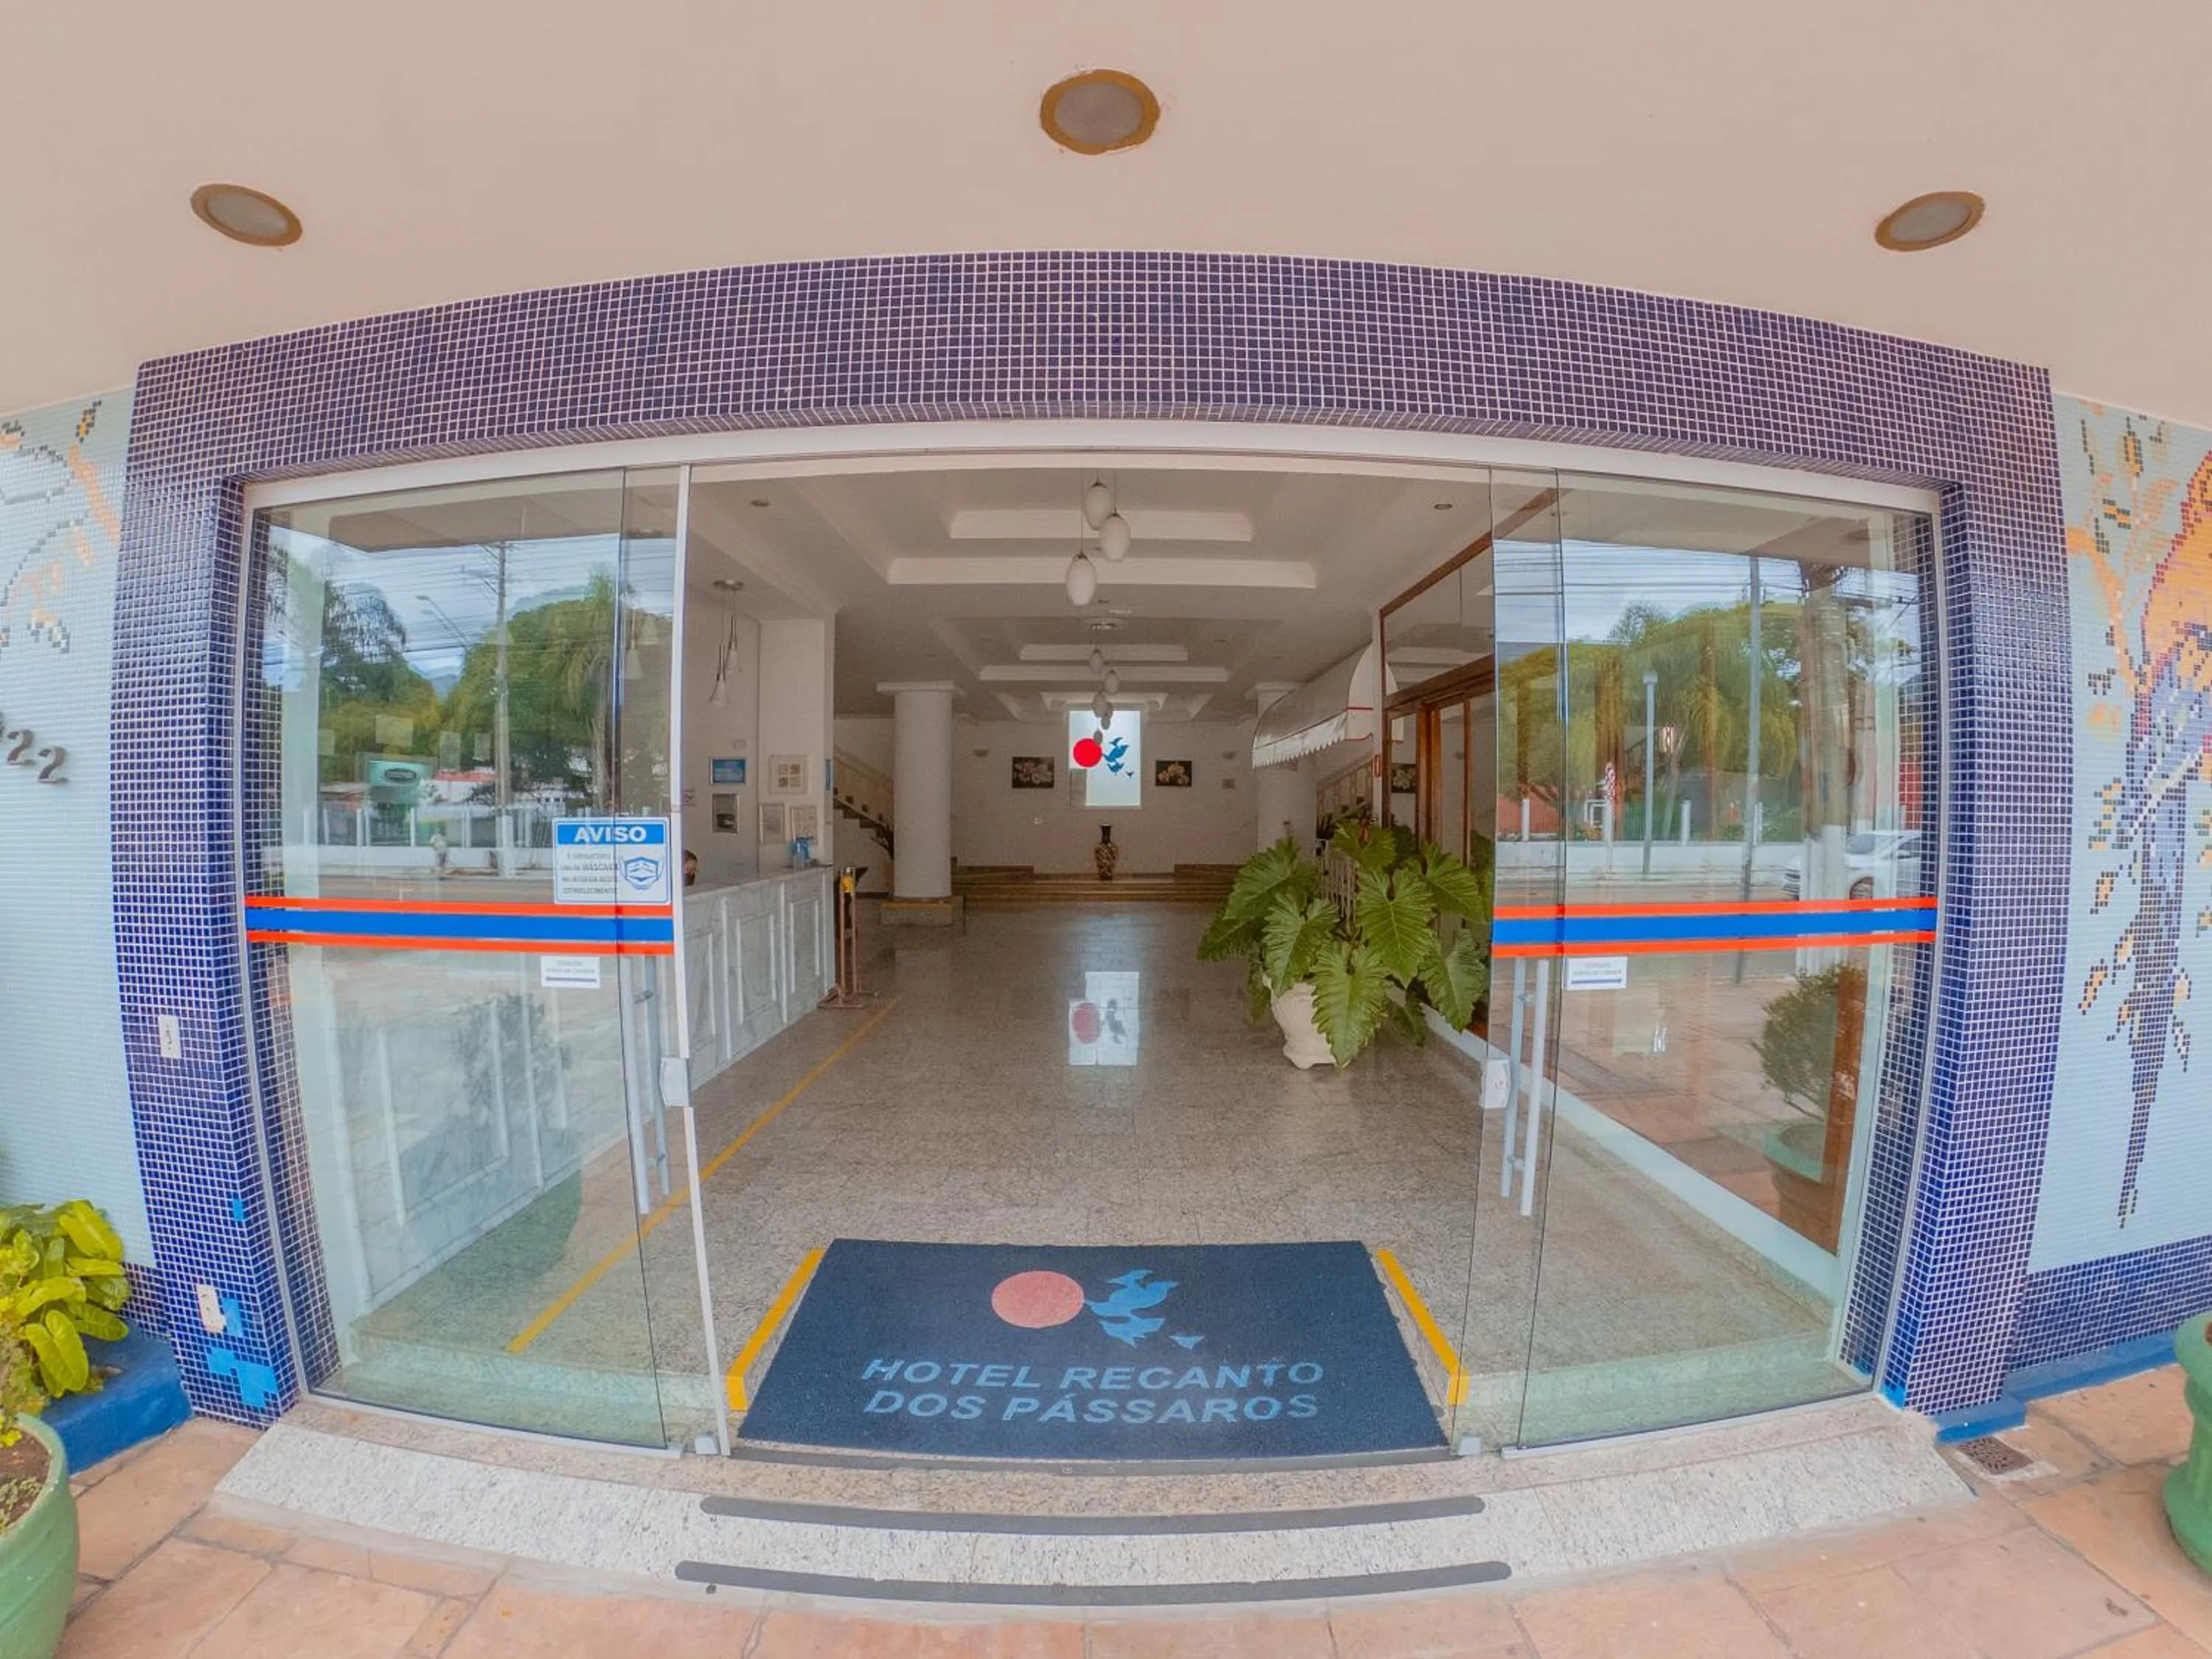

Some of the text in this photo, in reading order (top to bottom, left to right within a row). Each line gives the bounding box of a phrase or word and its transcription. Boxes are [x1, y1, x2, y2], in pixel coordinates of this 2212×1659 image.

[0, 712, 69, 784] 22
[574, 825, 647, 843] AVISO
[861, 1359, 1324, 1390] HOTEL RECANTO
[863, 1390, 1318, 1424] DOS PÁSSAROS
